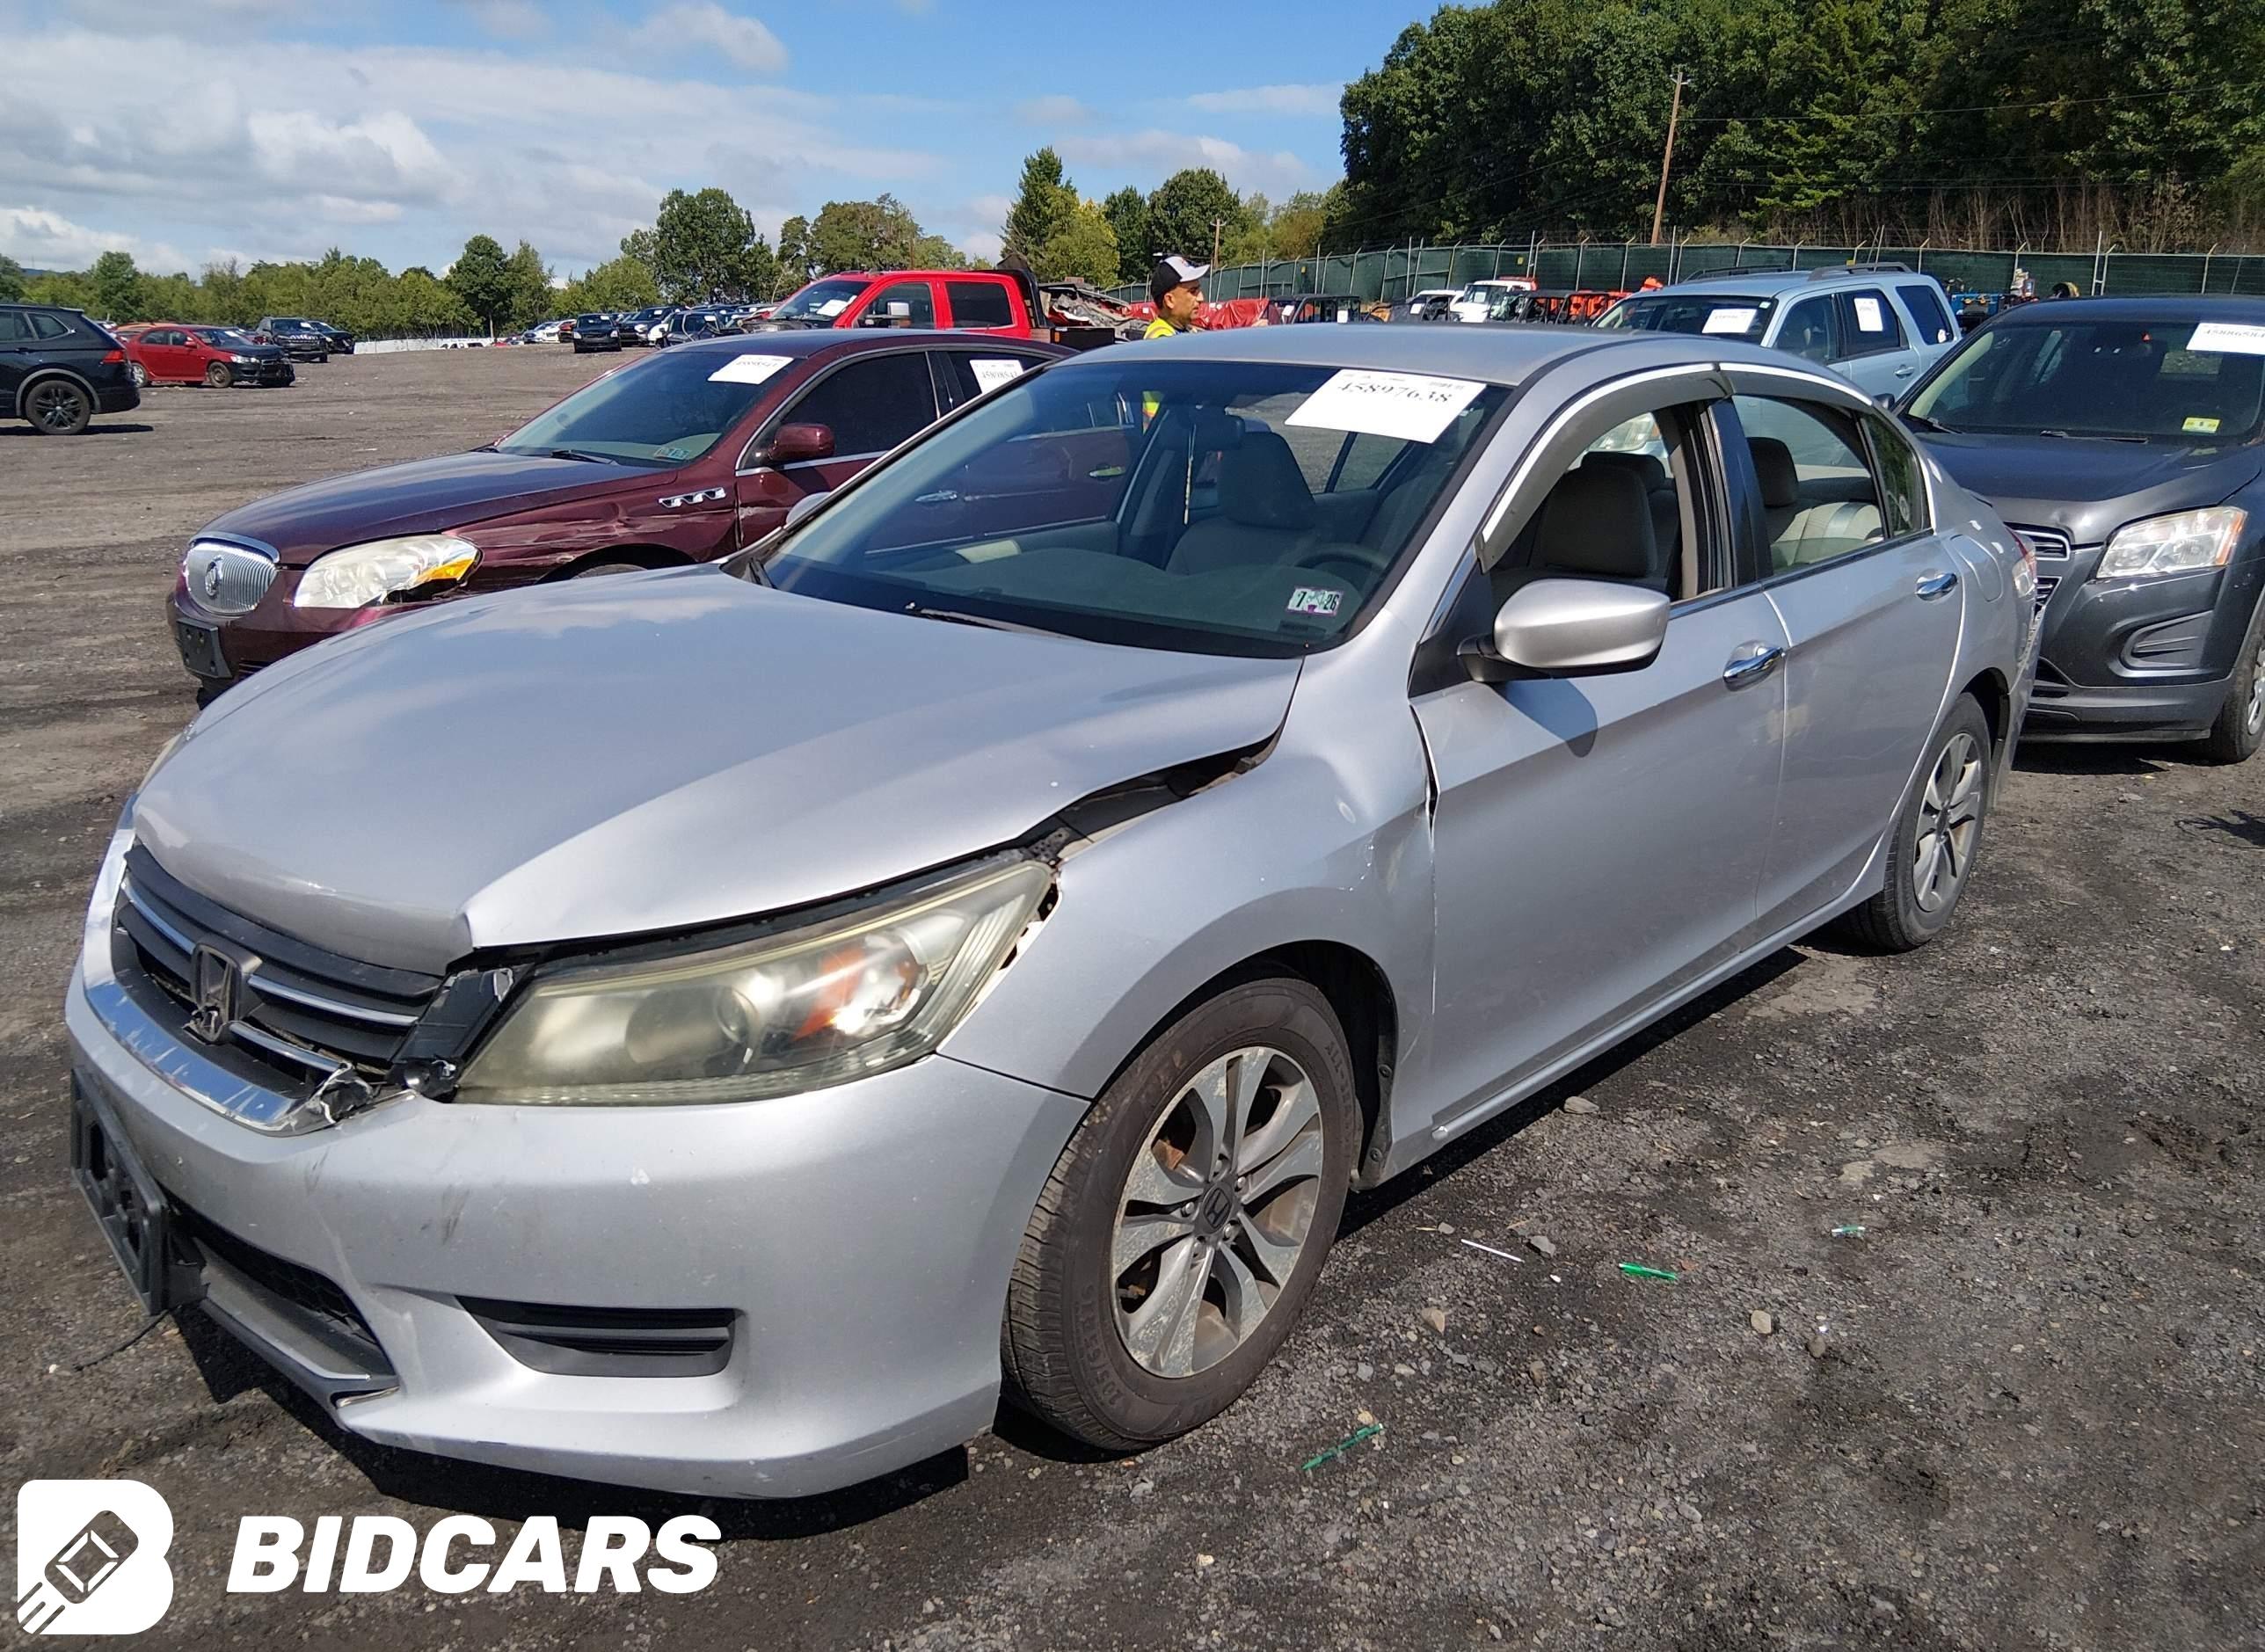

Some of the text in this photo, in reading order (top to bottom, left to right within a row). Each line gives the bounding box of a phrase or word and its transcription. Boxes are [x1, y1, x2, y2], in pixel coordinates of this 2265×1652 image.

[1337, 382, 1453, 403] 45897638
[1296, 591, 1340, 611] 7 26
